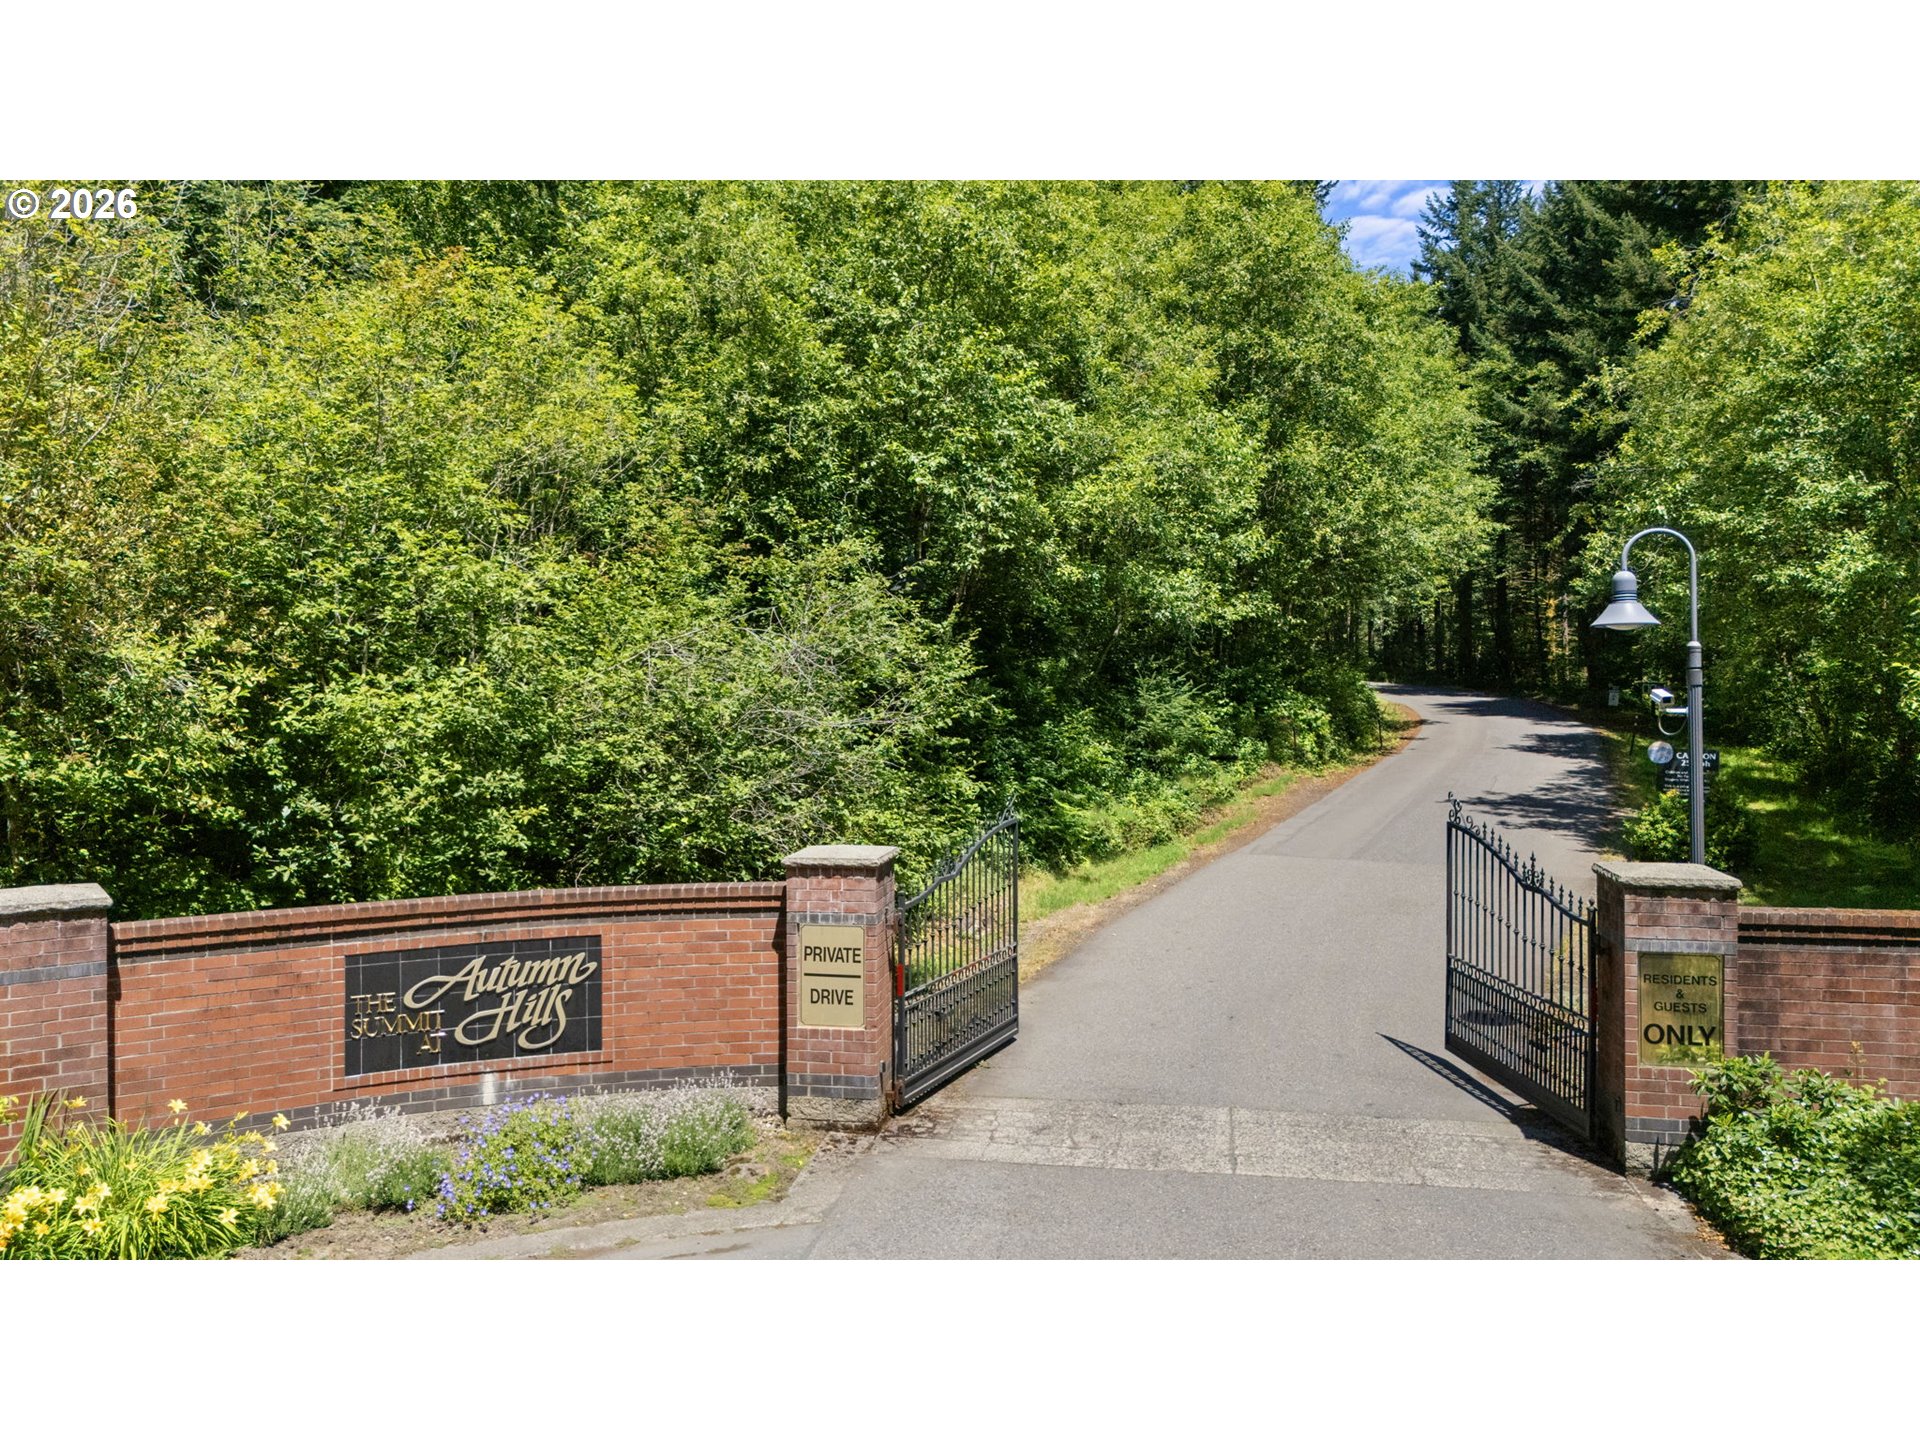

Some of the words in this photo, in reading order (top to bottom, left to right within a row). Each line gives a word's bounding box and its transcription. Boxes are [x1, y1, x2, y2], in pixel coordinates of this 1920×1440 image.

[1676, 752, 1717, 760] CAON
[804, 945, 861, 963] PRIVATE
[403, 952, 598, 1009] Autumn
[1643, 974, 1717, 986] RESIDENTS
[350, 991, 397, 1015] THE
[810, 988, 853, 1005] DRIVE
[1675, 988, 1684, 999] &
[454, 985, 573, 1049] Hills
[1653, 1001, 1708, 1013] GUESTS
[350, 1009, 445, 1039] SUMMIT
[416, 1031, 447, 1055] AT
[1643, 1023, 1716, 1046] ONLY
